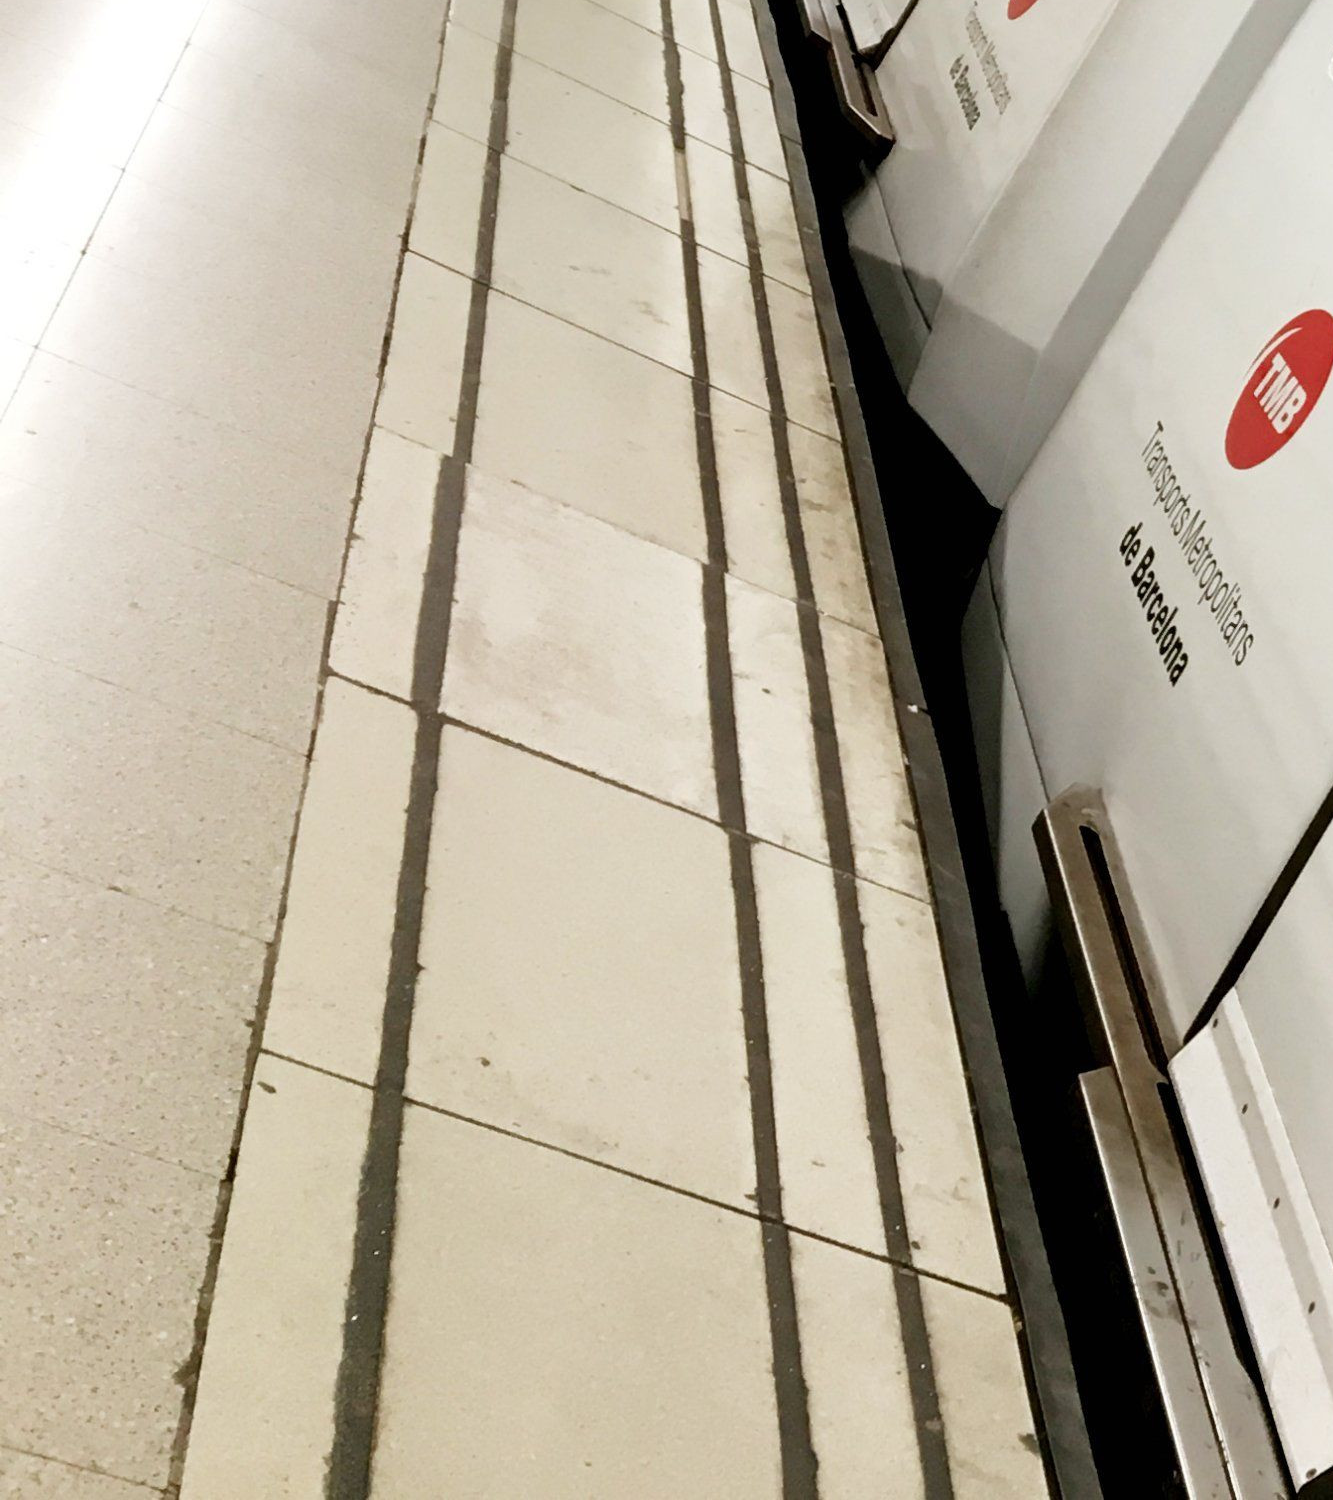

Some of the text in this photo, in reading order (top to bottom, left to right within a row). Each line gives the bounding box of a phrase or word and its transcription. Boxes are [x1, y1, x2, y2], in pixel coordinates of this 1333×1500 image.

[1253, 352, 1307, 434] TMB
[1119, 522, 1190, 688] de Barcelona
[1142, 421, 1255, 667] Transports Metropolitans
